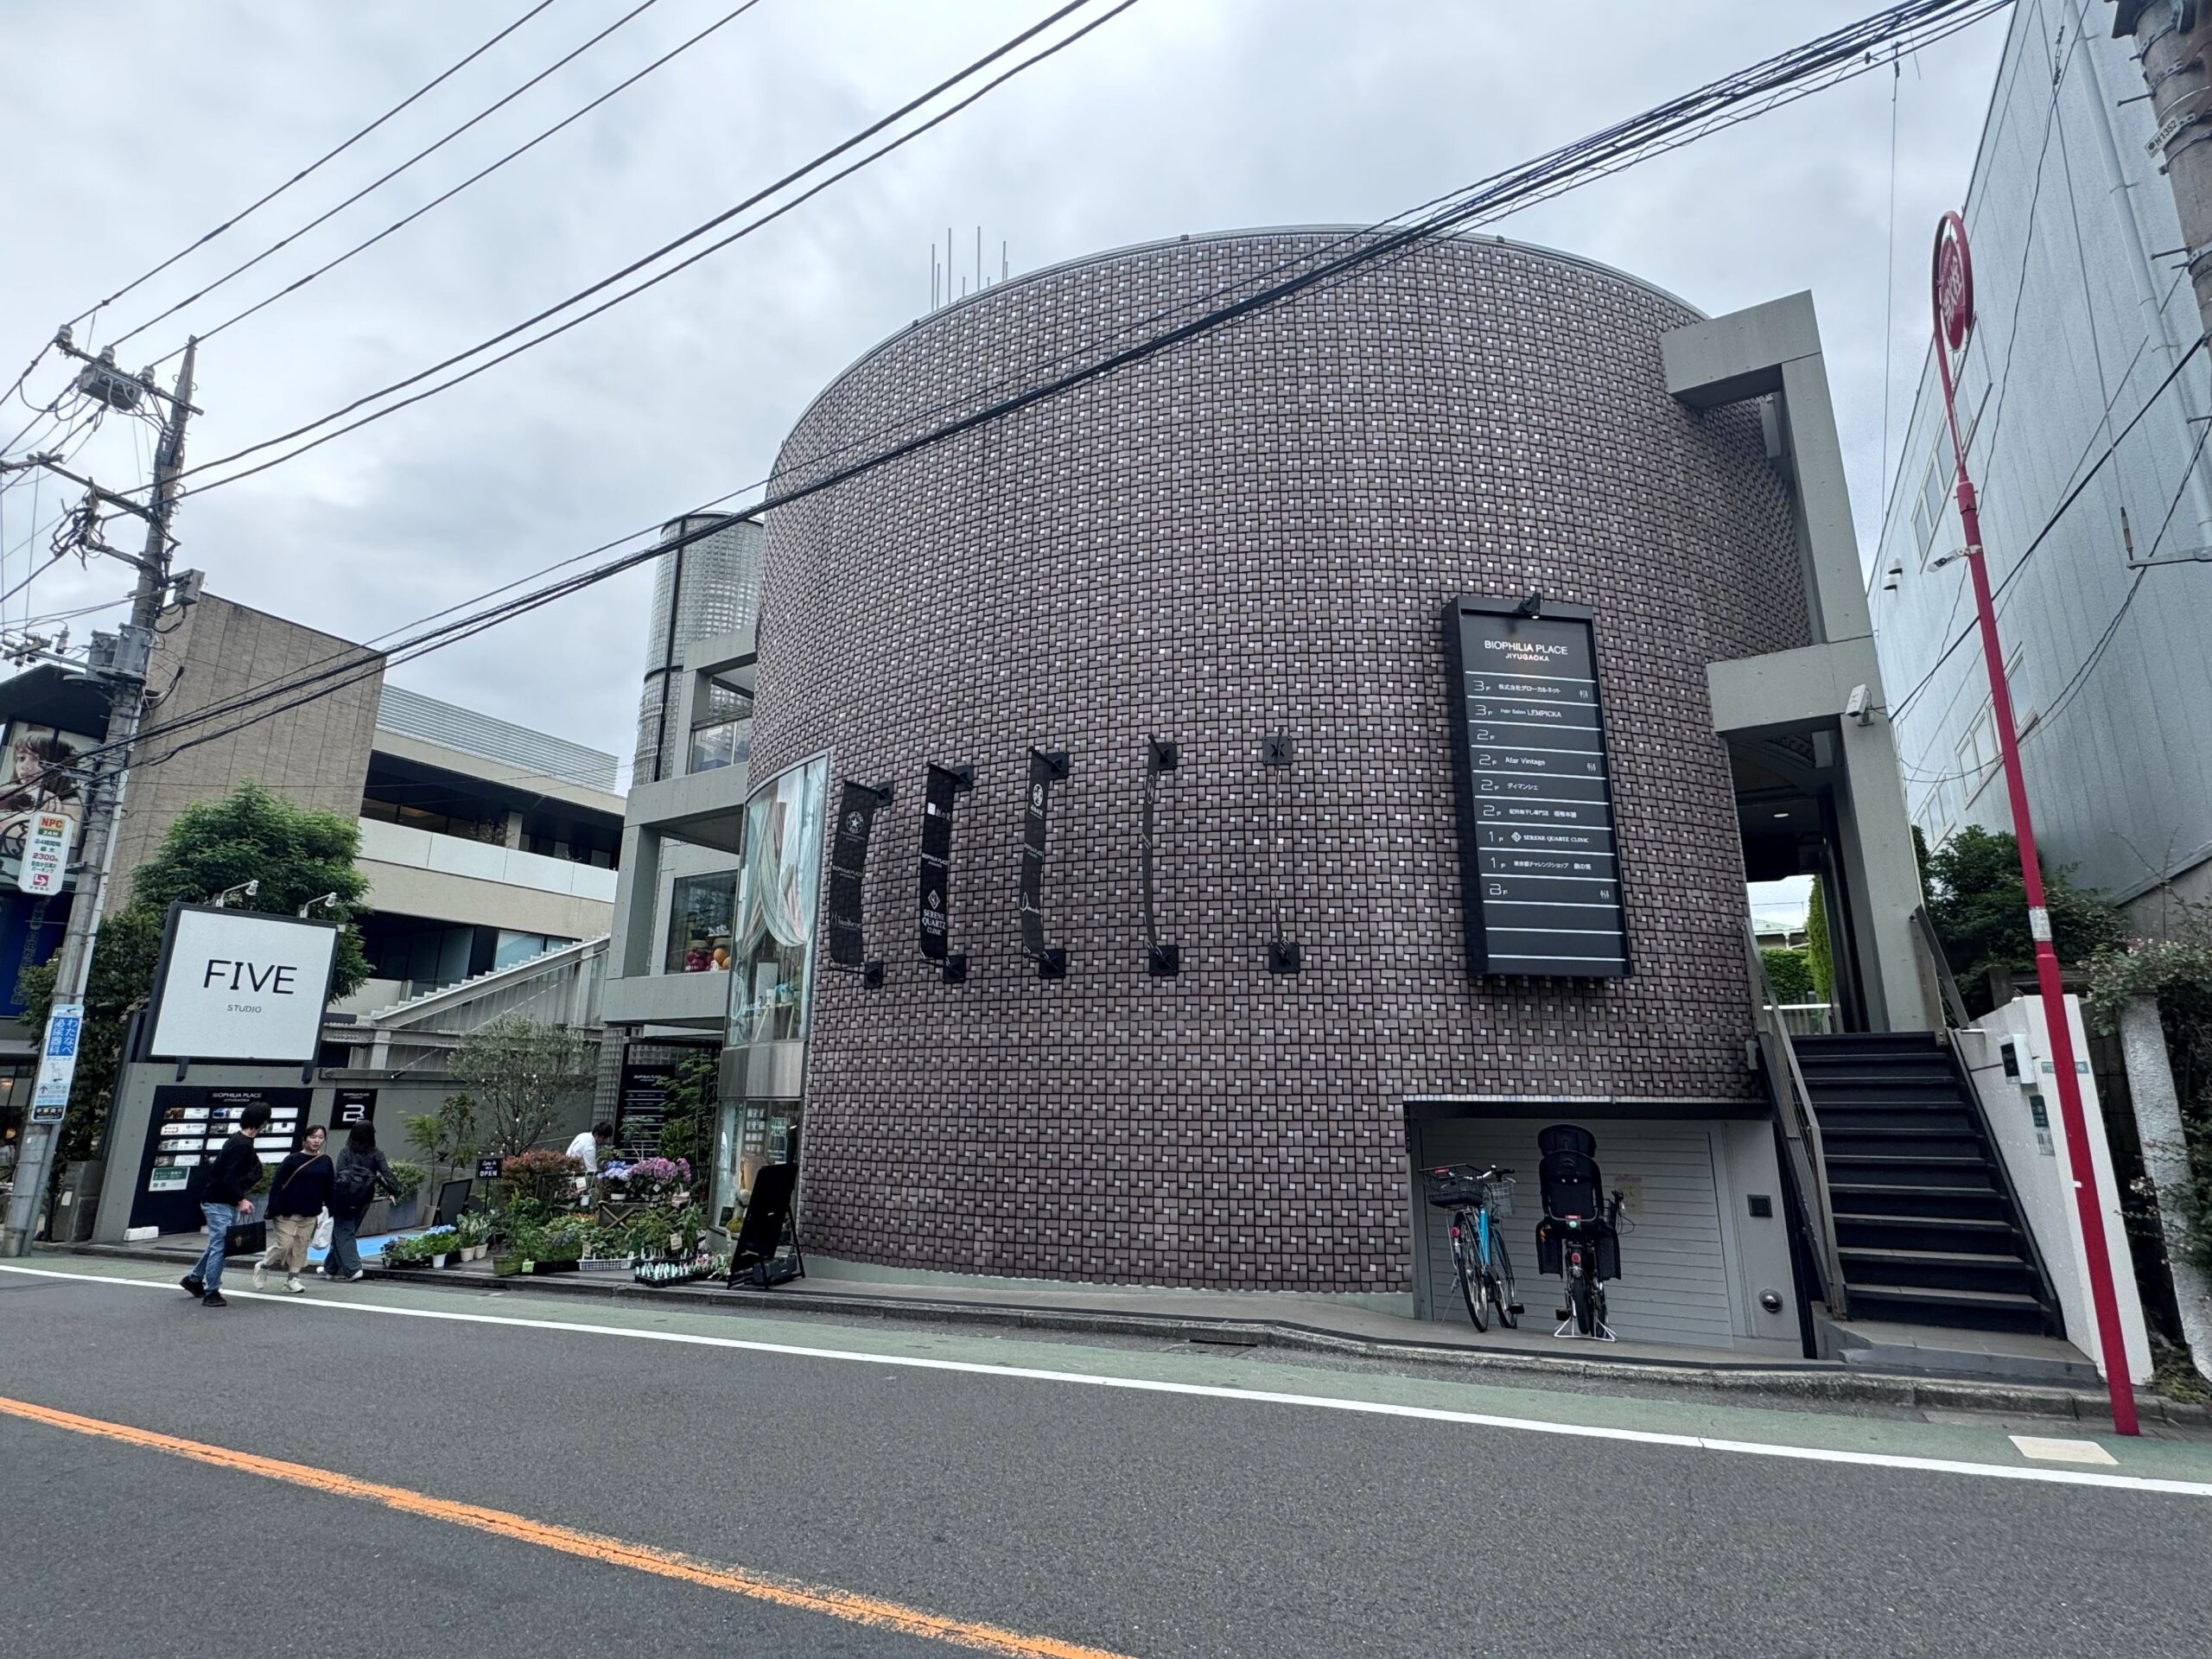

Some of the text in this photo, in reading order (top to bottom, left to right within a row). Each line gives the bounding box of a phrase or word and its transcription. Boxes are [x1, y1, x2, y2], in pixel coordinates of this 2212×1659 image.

[2154, 119, 2178, 146] H1352
[1484, 639, 1568, 655] BIOPHILIA PLACE
[1505, 652, 1550, 662] JIYUGAOKA
[1472, 680, 1491, 691] 3F
[1474, 704, 1493, 715] 3F
[1477, 728, 1496, 741] 2F
[1478, 753, 1497, 766] 2F
[1521, 757, 1546, 766] Vintage
[1481, 779, 1499, 791] 2F
[1483, 804, 1502, 817] 2F
[41, 817, 63, 828] NPC
[1547, 835, 1570, 843] QUARTZ
[923, 909, 945, 921] SERENE
[922, 917, 946, 930] QUARTZ
[203, 959, 297, 995] FIVE
[226, 1004, 262, 1014] STUDIO
[48, 1018, 66, 1054] 泌尿器科
[62, 1019, 79, 1054] わたなべ
